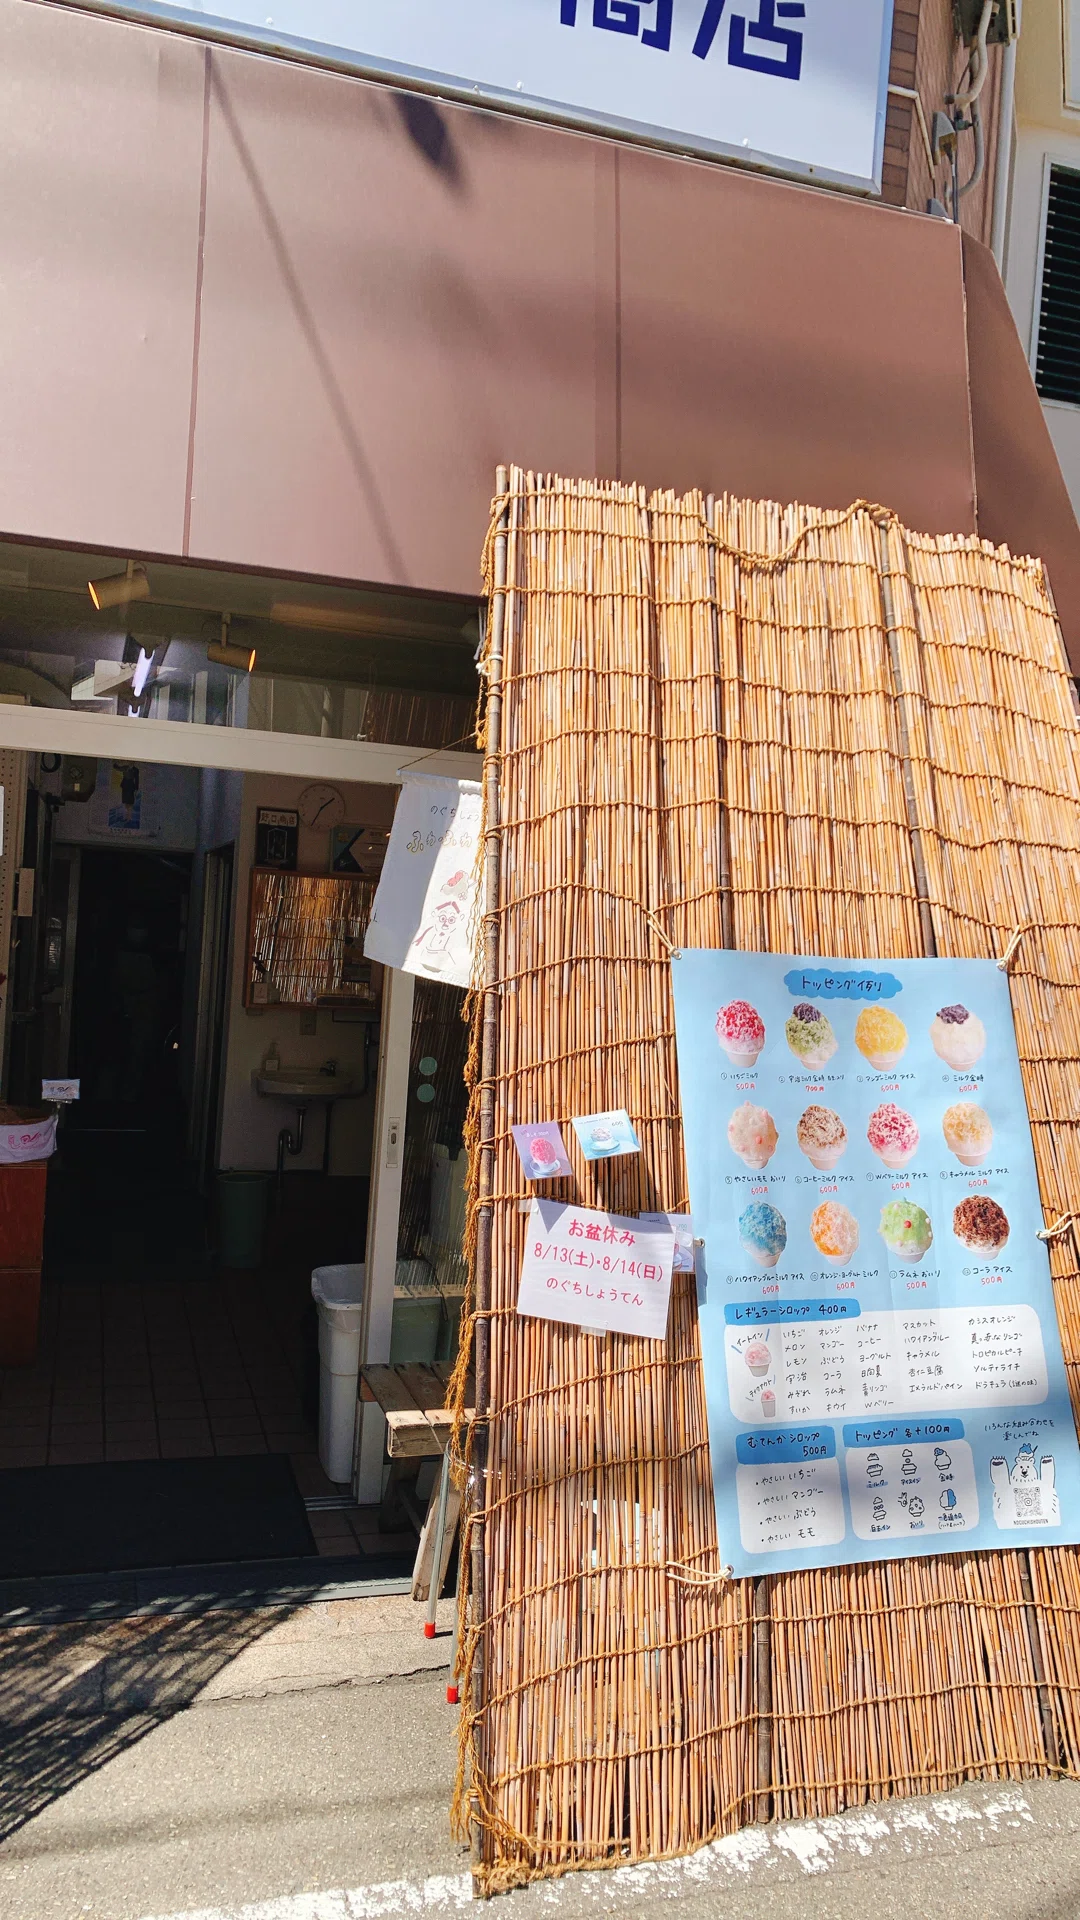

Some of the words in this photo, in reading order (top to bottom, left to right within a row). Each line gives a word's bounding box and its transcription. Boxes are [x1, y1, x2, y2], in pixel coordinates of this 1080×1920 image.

[802, 976, 882, 992] トッピング例
[953, 1074, 984, 1082] ミルク金時
[881, 1084, 900, 1093] 600円
[959, 1084, 979, 1093] 600円
[891, 1182, 911, 1190] 600円
[968, 1178, 988, 1187] 600円
[751, 1186, 769, 1195] 600円
[568, 1218, 637, 1248] お盆休み
[533, 1242, 664, 1283] 8/13(土)・8/14(日)
[862, 1269, 879, 1277] ミルク
[972, 1266, 991, 1275] コーラ
[993, 1265, 1013, 1273] アイス
[790, 1272, 805, 1280] アイス
[981, 1276, 1003, 1285] 500円
[762, 1284, 780, 1294] 600円
[836, 1281, 855, 1290] 600円
[906, 1281, 927, 1290] 500円
[546, 1277, 644, 1306] のぐちしょうてん
[735, 1305, 810, 1320] レギュラーシロップ
[818, 1304, 847, 1315] 400円
[902, 1319, 936, 1331] マスカット
[968, 1315, 1016, 1326] カシスオレンジ
[783, 1328, 806, 1339] いちご
[818, 1325, 843, 1337] オレンジ
[856, 1324, 879, 1332] バナナ
[857, 1337, 882, 1348] コーヒー
[904, 1331, 950, 1344] ハワイアンブルー
[971, 1332, 1023, 1344] 真っ赤なリンゴ
[785, 1343, 806, 1353] メロン
[820, 1340, 845, 1349] マンゴー
[859, 1352, 892, 1363] ヨーグルト
[906, 1349, 941, 1361] キャラメル
[972, 1347, 1023, 1359] トロピカルピーチ
[786, 1357, 808, 1368] レモン
[820, 1356, 845, 1366] ぶどう
[823, 1370, 843, 1381] コーラ
[861, 1364, 883, 1378] 日向夏
[825, 1384, 847, 1397] ラムネ
[788, 1405, 811, 1415] すいか
[826, 1403, 847, 1413] キウイ
[864, 1400, 894, 1409] Wベリー
[855, 1427, 899, 1442] トッピング
[747, 1433, 787, 1449] むてんか
[789, 1432, 820, 1444] シロップ
[802, 1445, 827, 1457] 500円
[761, 1476, 785, 1486] やさしい
[788, 1468, 817, 1480] いちご
[763, 1495, 788, 1505] やさしい
[791, 1488, 823, 1500] マンゴー
[765, 1514, 790, 1524] やさしい
[794, 1507, 817, 1520] ぶどう
[767, 1533, 791, 1543] やさしい
[797, 1527, 816, 1539] モモ
